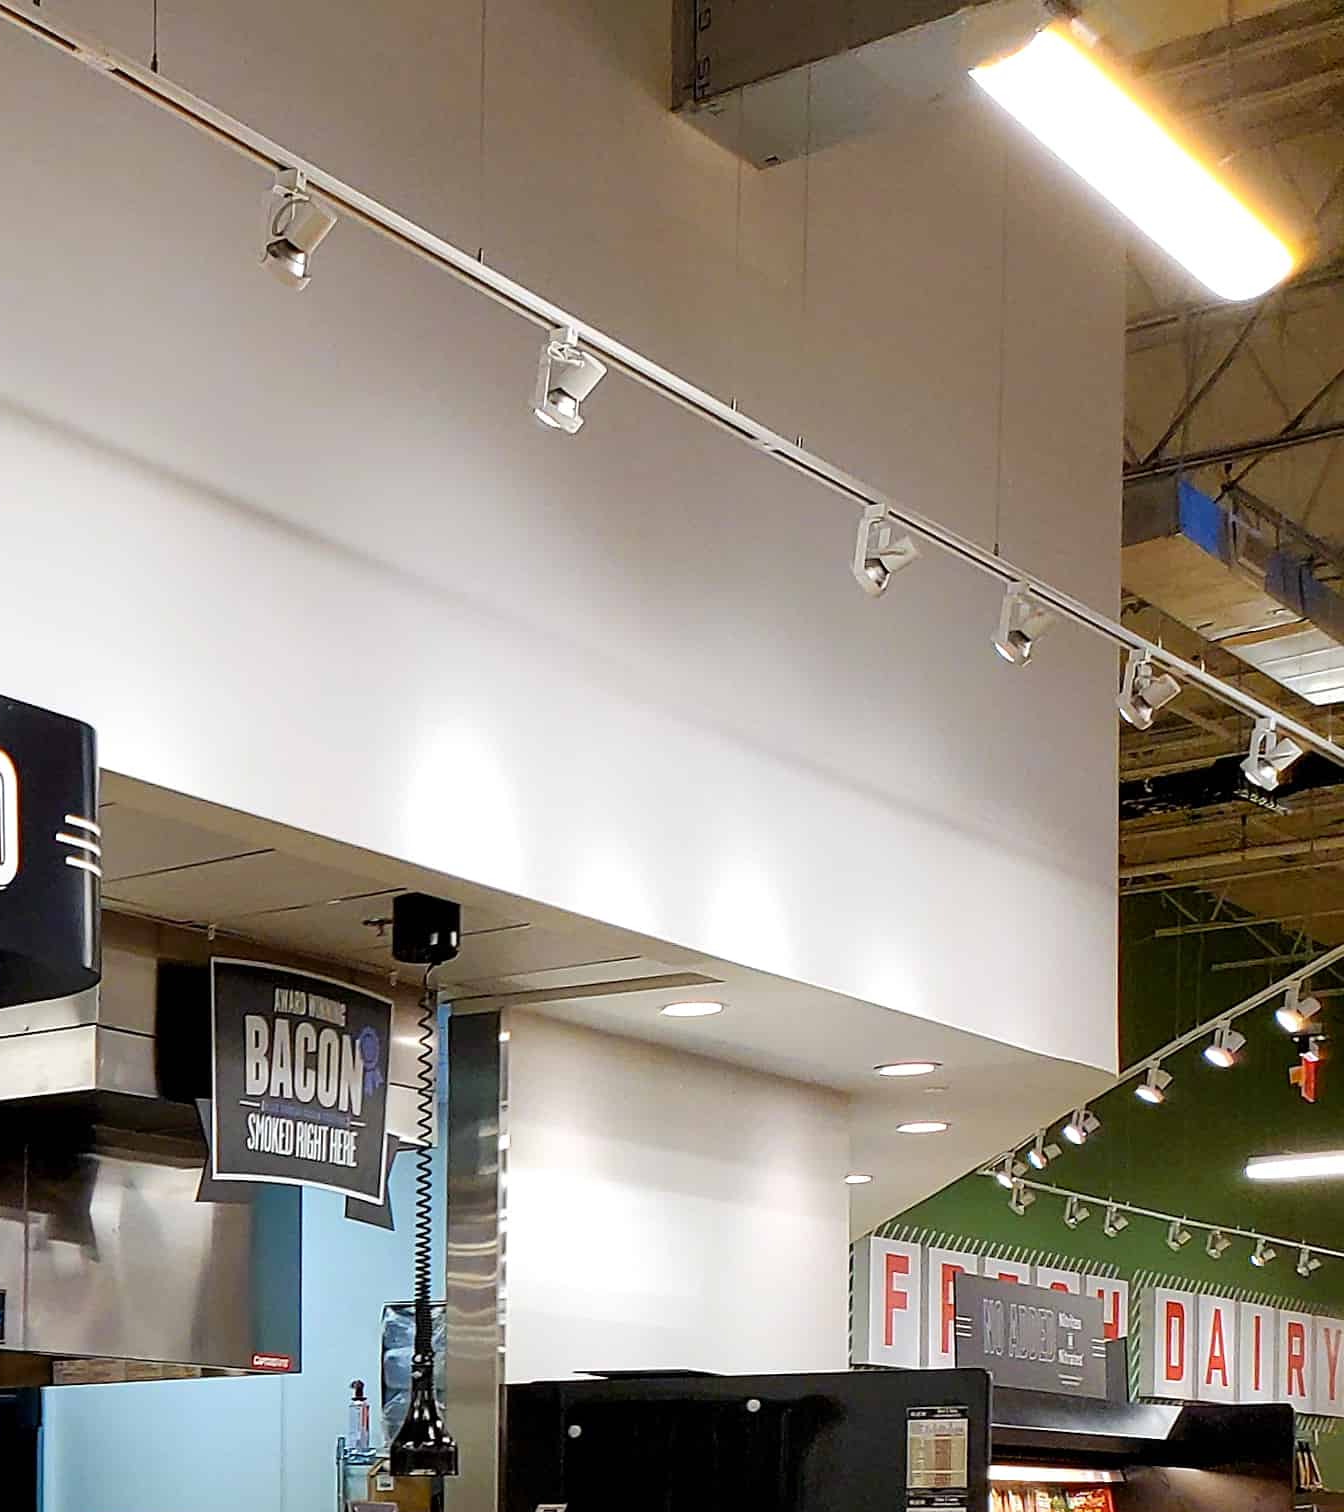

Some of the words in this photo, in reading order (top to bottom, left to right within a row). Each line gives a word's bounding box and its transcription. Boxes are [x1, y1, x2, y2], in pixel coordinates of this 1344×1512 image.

[245, 1015, 363, 1116] BACON
[247, 1113, 293, 1155] SMOKED
[296, 1121, 328, 1162] RIGHT
[330, 1128, 358, 1167] HERE
[1165, 1300, 1343, 1401] DAIRY
